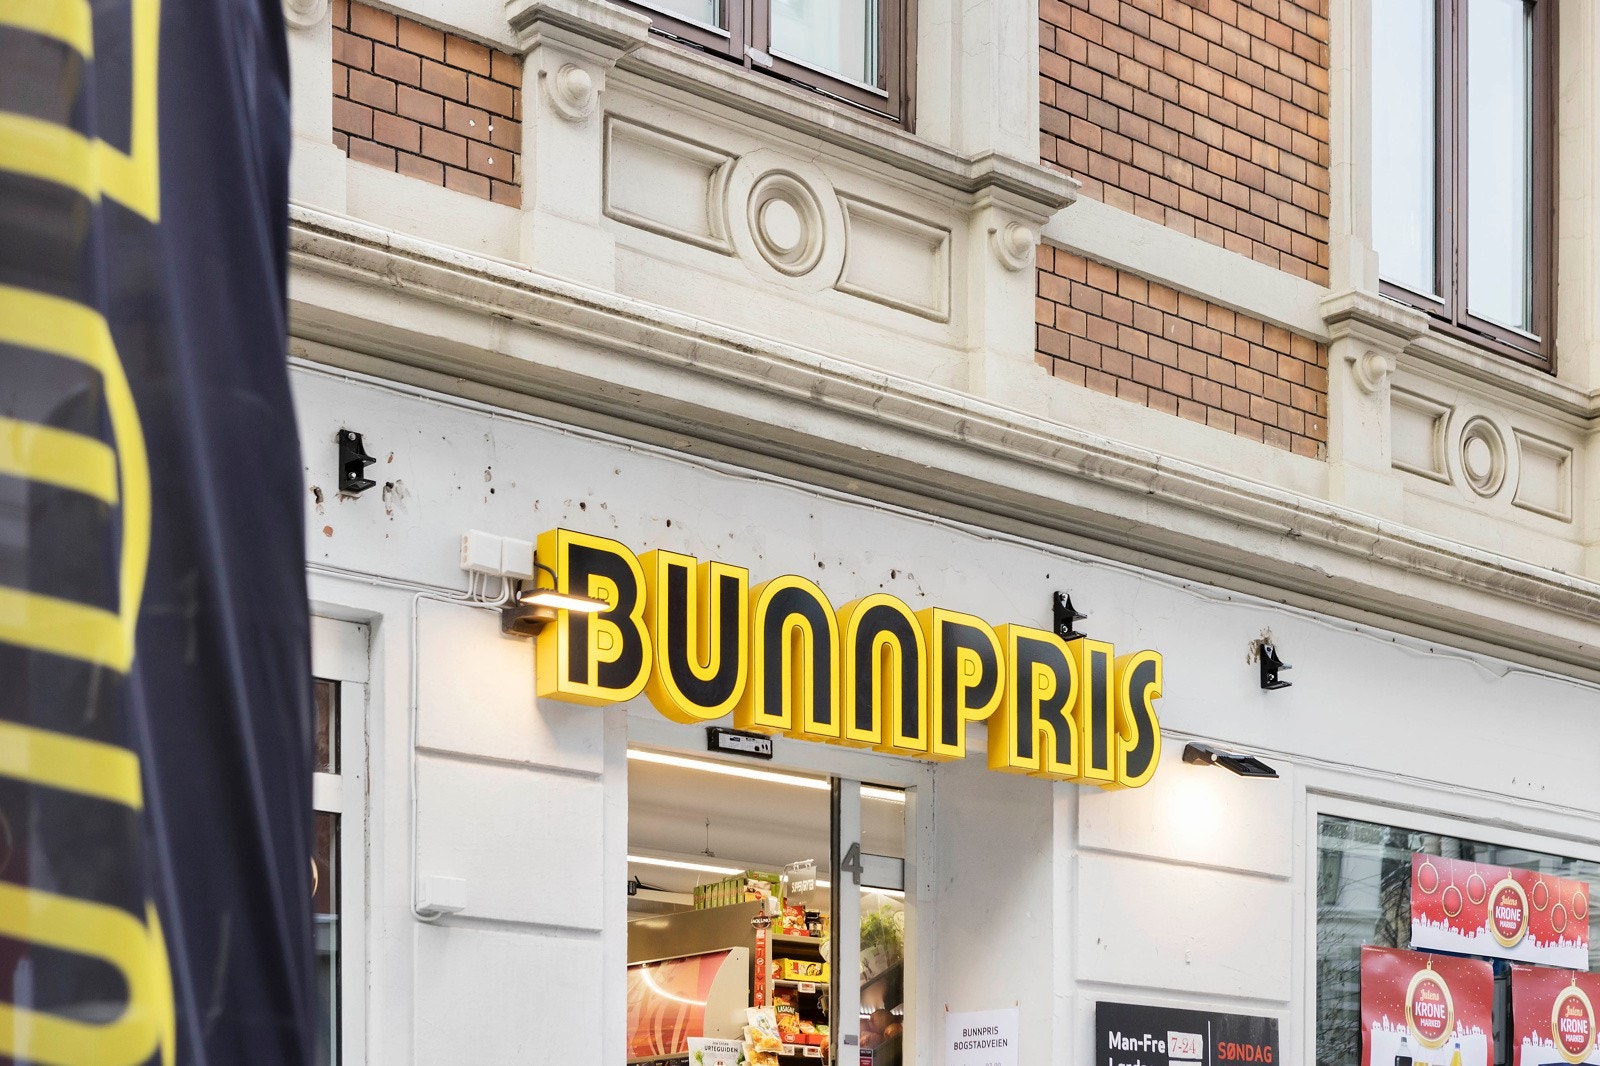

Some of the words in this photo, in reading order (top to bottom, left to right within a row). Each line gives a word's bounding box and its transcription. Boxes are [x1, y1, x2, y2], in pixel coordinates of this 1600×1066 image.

[538, 527, 1163, 789] BUNNPRIS
[841, 842, 864, 885] 4
[1500, 895, 1518, 906] Julens
[1495, 906, 1521, 922] KRONE
[1499, 920, 1517, 930] MARKED
[1419, 988, 1440, 1002] Julens
[1415, 1001, 1446, 1020] KRONE
[1565, 1005, 1583, 1018] Julens
[1420, 1018, 1441, 1028] MARKED
[1560, 1017, 1588, 1034] KRONE
[962, 1026, 999, 1037] BUNNPRIS
[1565, 1033, 1585, 1043] MARKED
[704, 1045, 739, 1053] URTEGUIDEN
[953, 1038, 1008, 1051] BOGSTADVEIEN
[1108, 1030, 1166, 1054] Man-Fre
[1171, 1036, 1197, 1055] 7-24
[1217, 1041, 1273, 1064] SØNDAG
